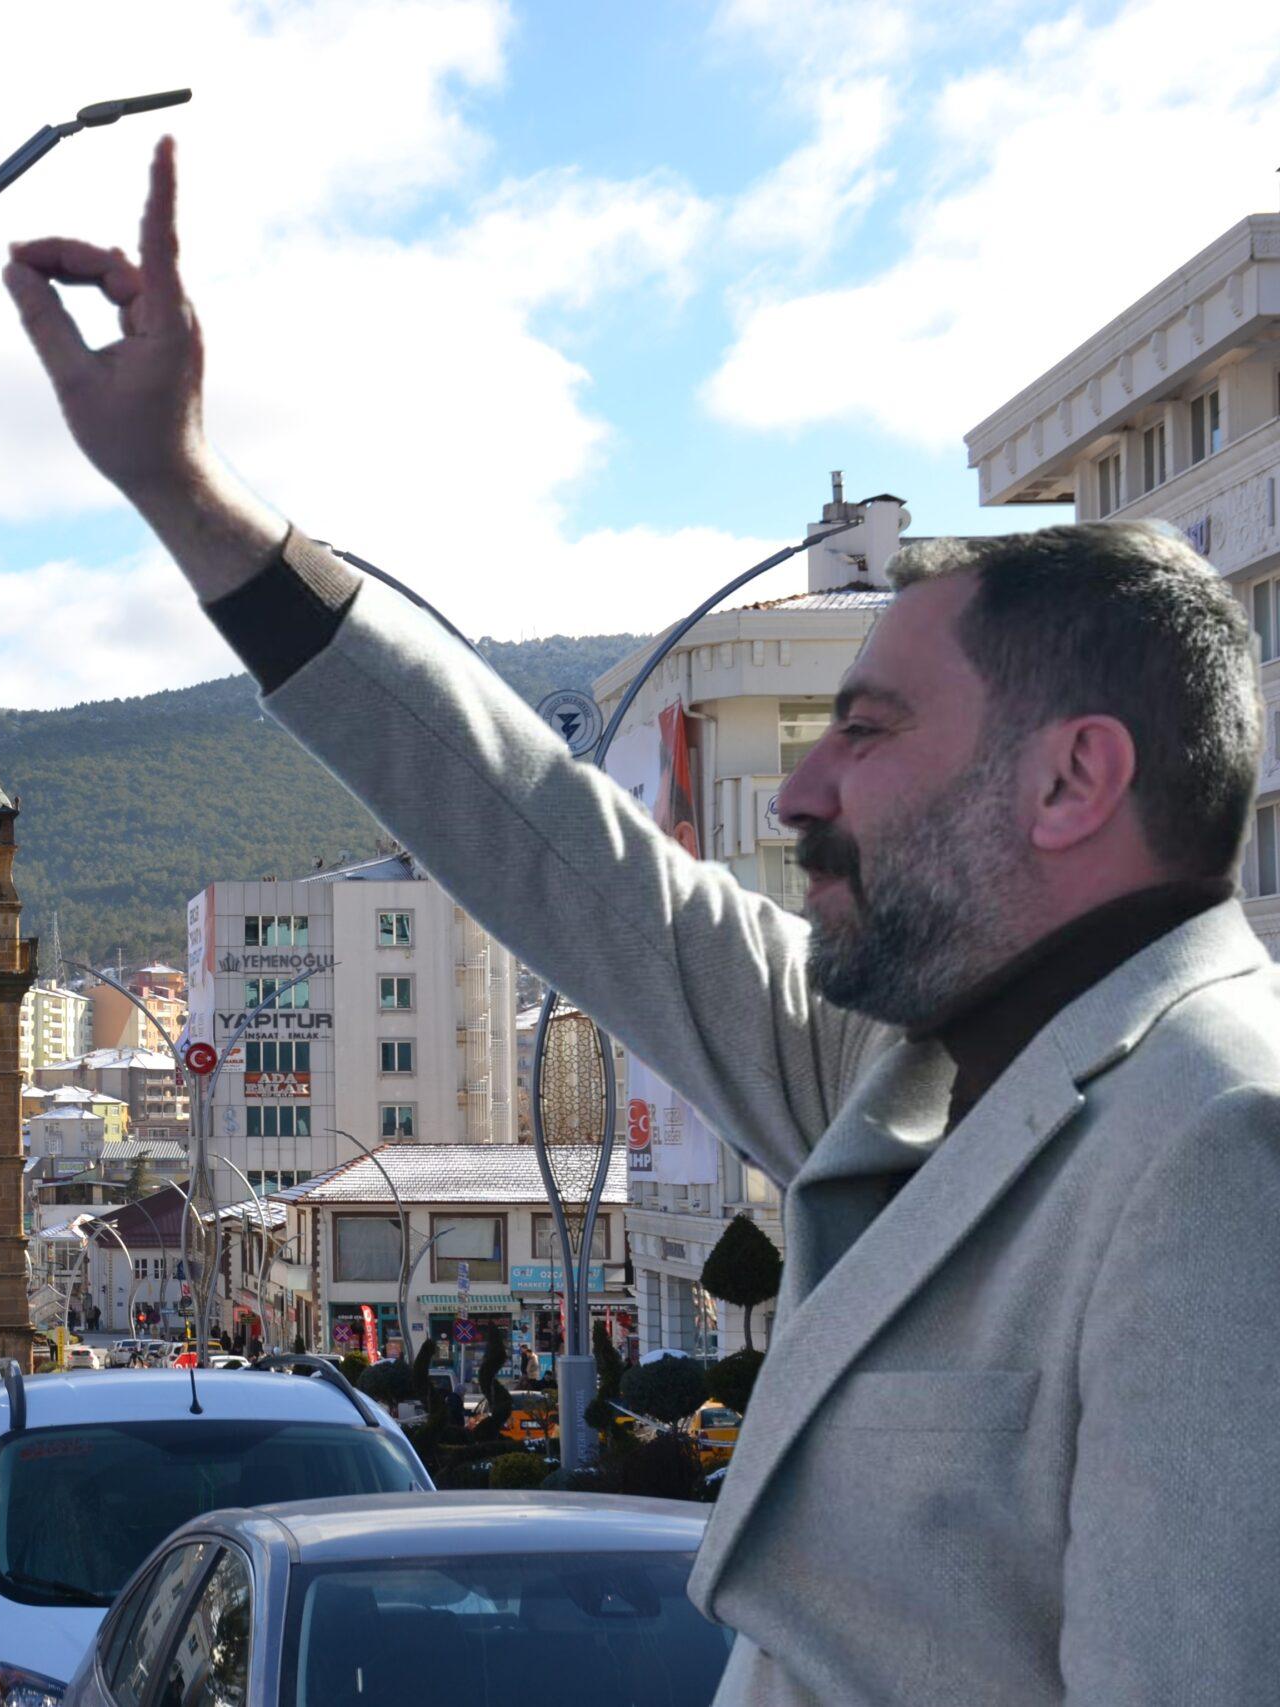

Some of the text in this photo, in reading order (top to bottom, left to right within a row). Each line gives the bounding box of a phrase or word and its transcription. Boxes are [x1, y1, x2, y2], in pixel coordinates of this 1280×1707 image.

[242, 952, 334, 968] YEMENOĞLU
[218, 1013, 332, 1029] YAPITUR
[257, 1072, 297, 1084] ADA
[245, 1083, 309, 1095] EMLAK
